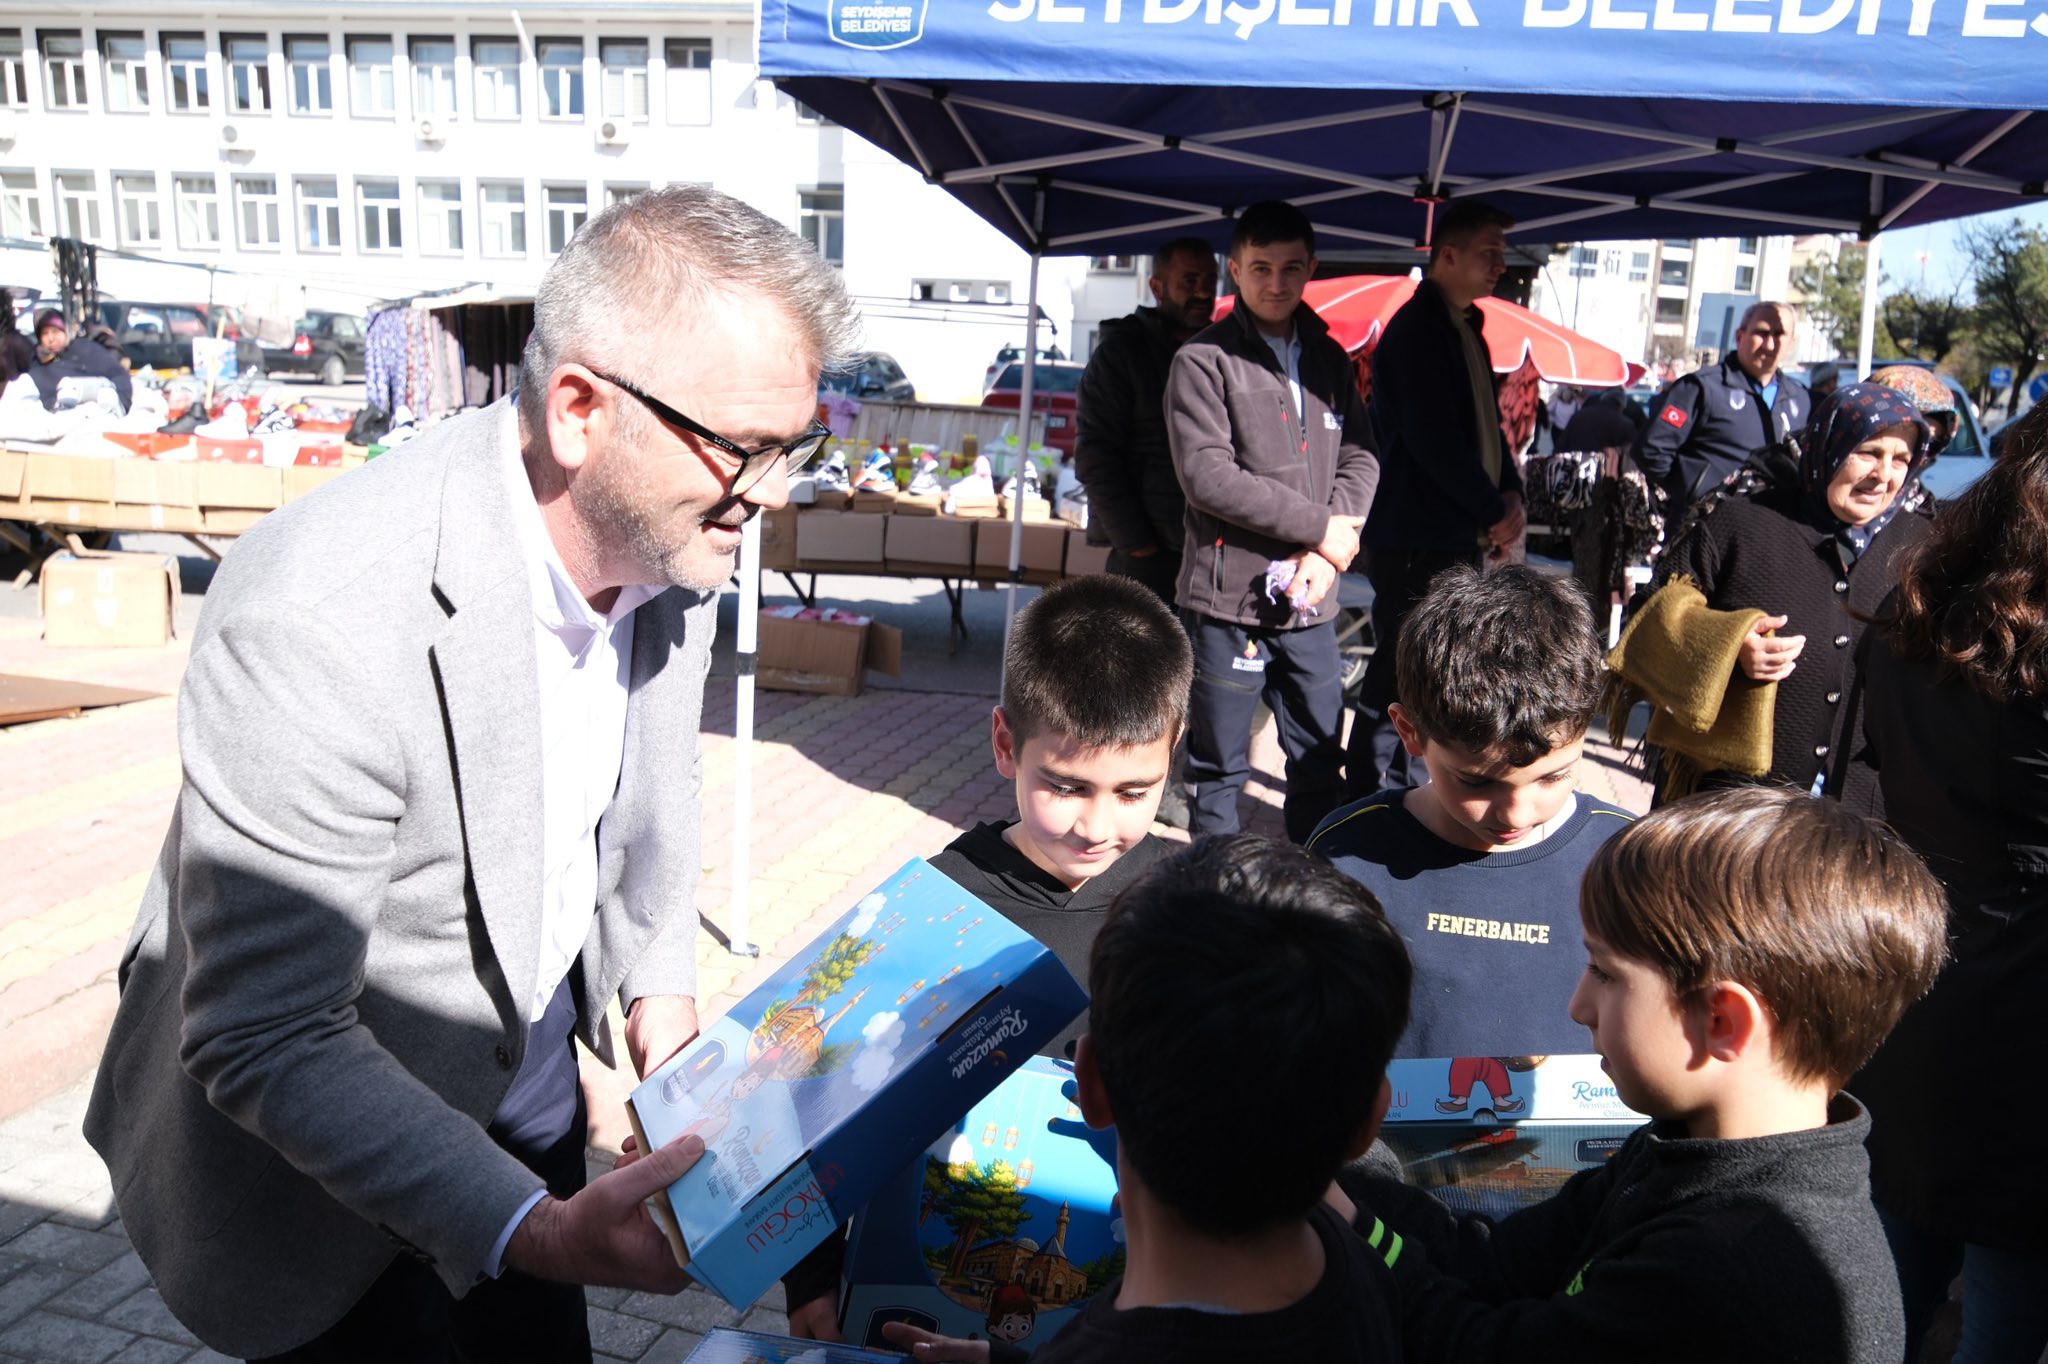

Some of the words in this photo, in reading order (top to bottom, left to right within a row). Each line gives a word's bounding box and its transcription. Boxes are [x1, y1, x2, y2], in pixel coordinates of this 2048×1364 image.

[841, 19, 911, 33] BELEDİYESİ
[1427, 912, 1551, 945] FENERBAHÇE
[961, 1016, 987, 1038] Olsun
[952, 1009, 1028, 1079] Ramazan
